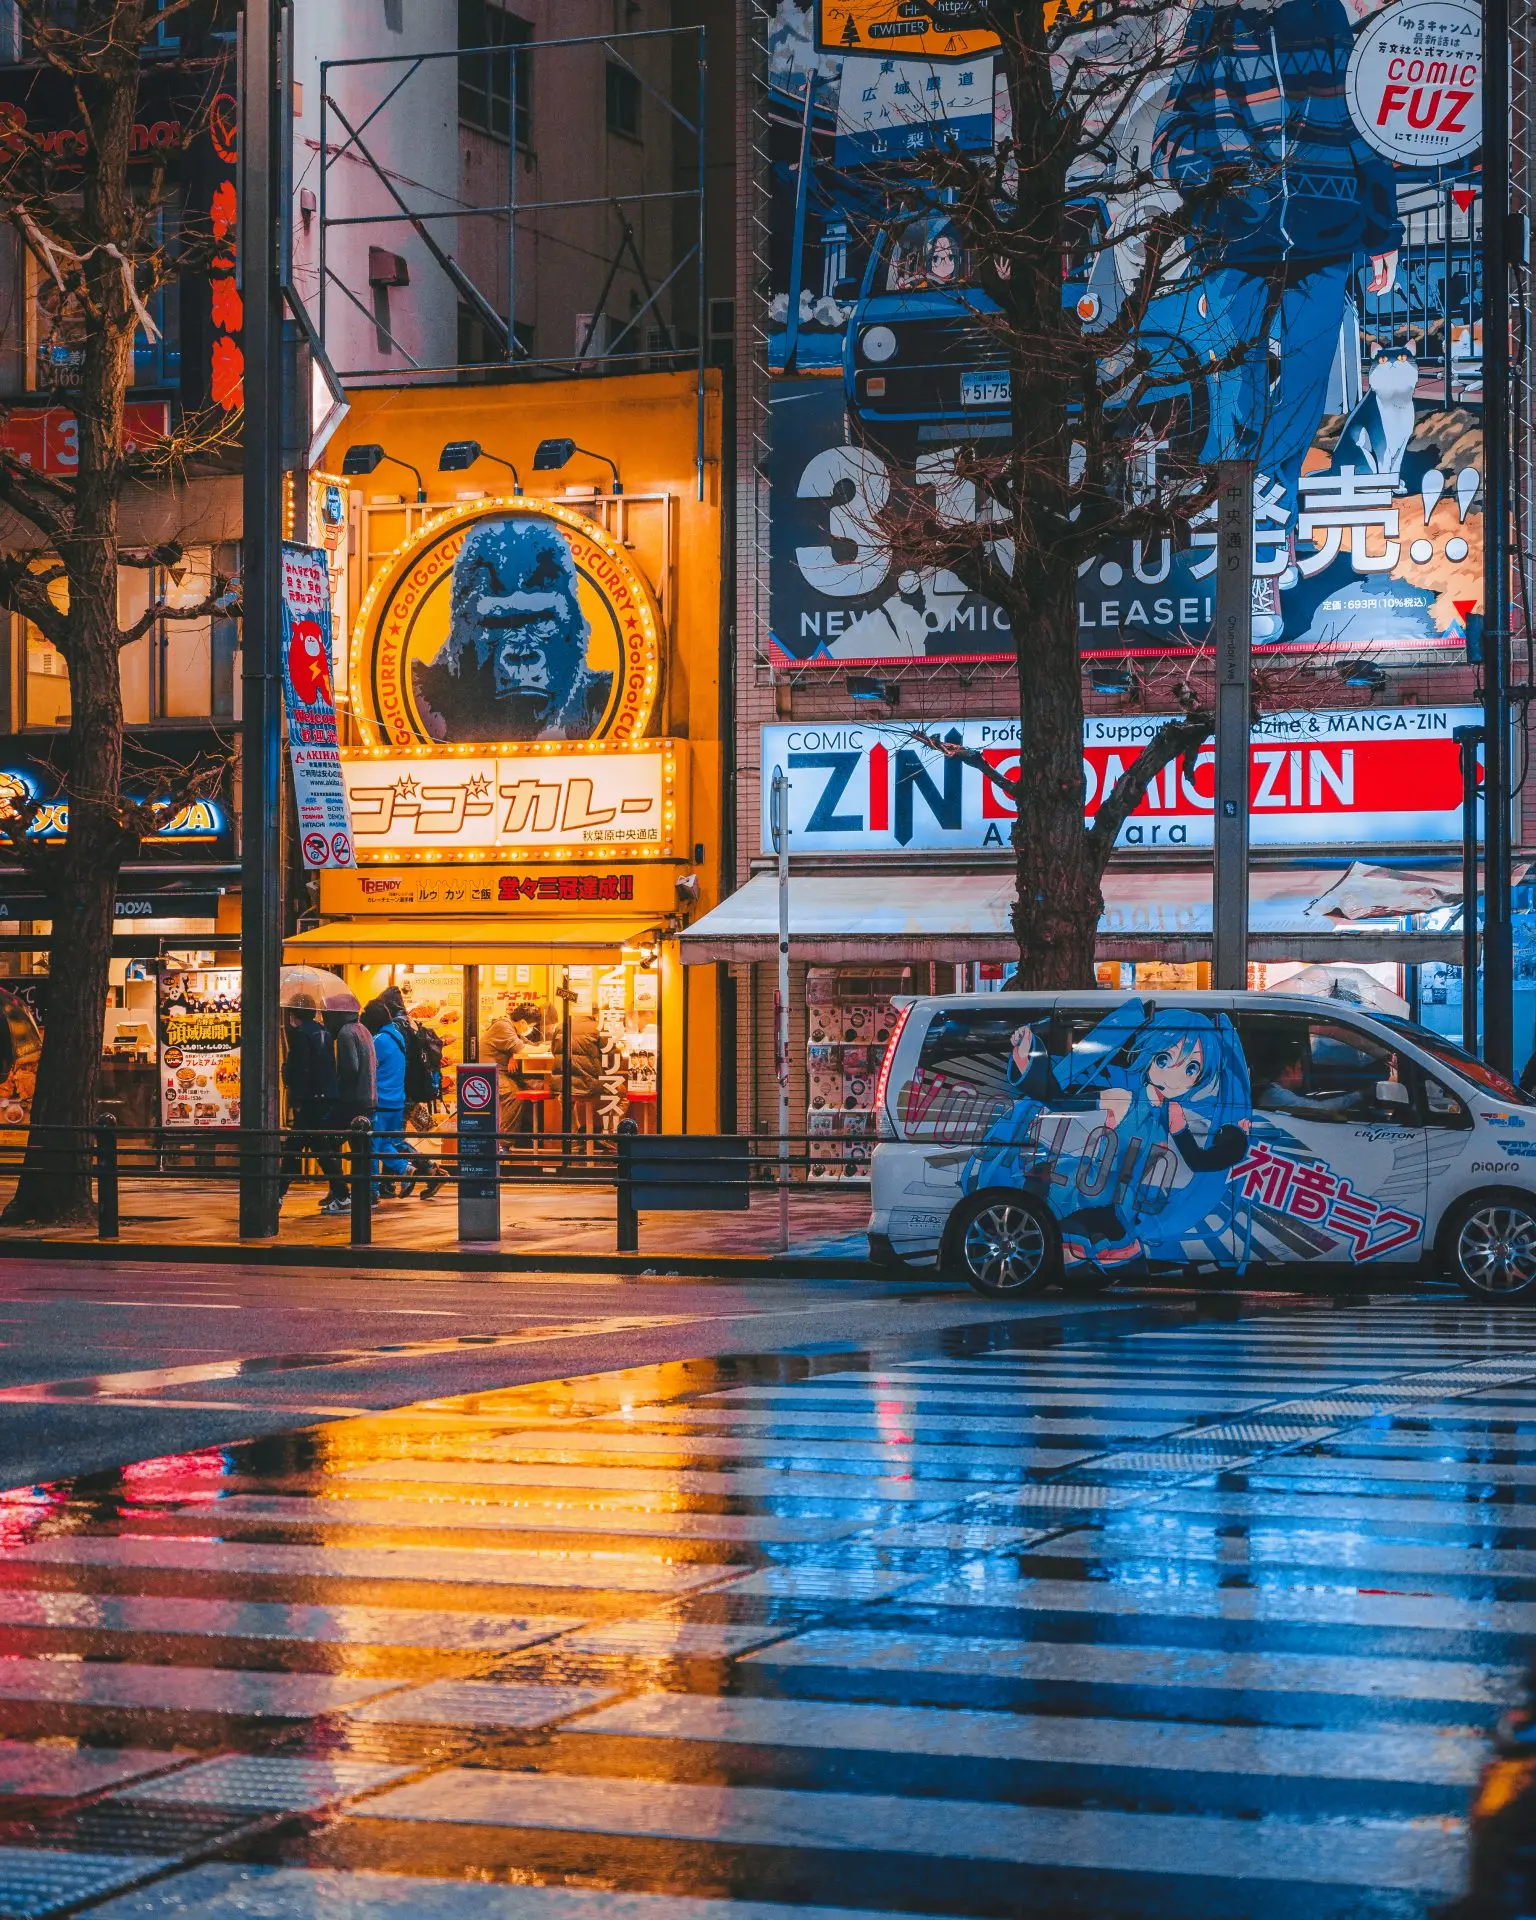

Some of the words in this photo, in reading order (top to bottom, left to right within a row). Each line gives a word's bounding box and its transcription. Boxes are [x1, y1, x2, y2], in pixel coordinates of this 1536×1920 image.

[871, 20, 926, 37] TWITTER
[1413, 32, 1460, 48] 最新話は
[1387, 57, 1477, 88] COMIC
[1376, 84, 1475, 133] FUZ
[1226, 487, 1243, 572] 中央通り
[1078, 597, 1213, 629] LEASE!
[1308, 716, 1321, 733] &
[1327, 712, 1448, 733] MANGA-ZIN
[786, 730, 864, 751] COMIC
[787, 726, 963, 848] ZIN
[1252, 748, 1356, 808] ZIN
[349, 772, 654, 835] ゴーゴーカレー
[582, 827, 659, 842] 秋葉原中央通店
[445, 888, 465, 901] カツ
[471, 888, 492, 901] ご飯
[498, 875, 634, 901] 堂々三冠達成!!
[1353, 1128, 1416, 1143] CRYPTON
[1471, 1161, 1520, 1174] piapro
[1226, 1142, 1425, 1264] 初音ミク
